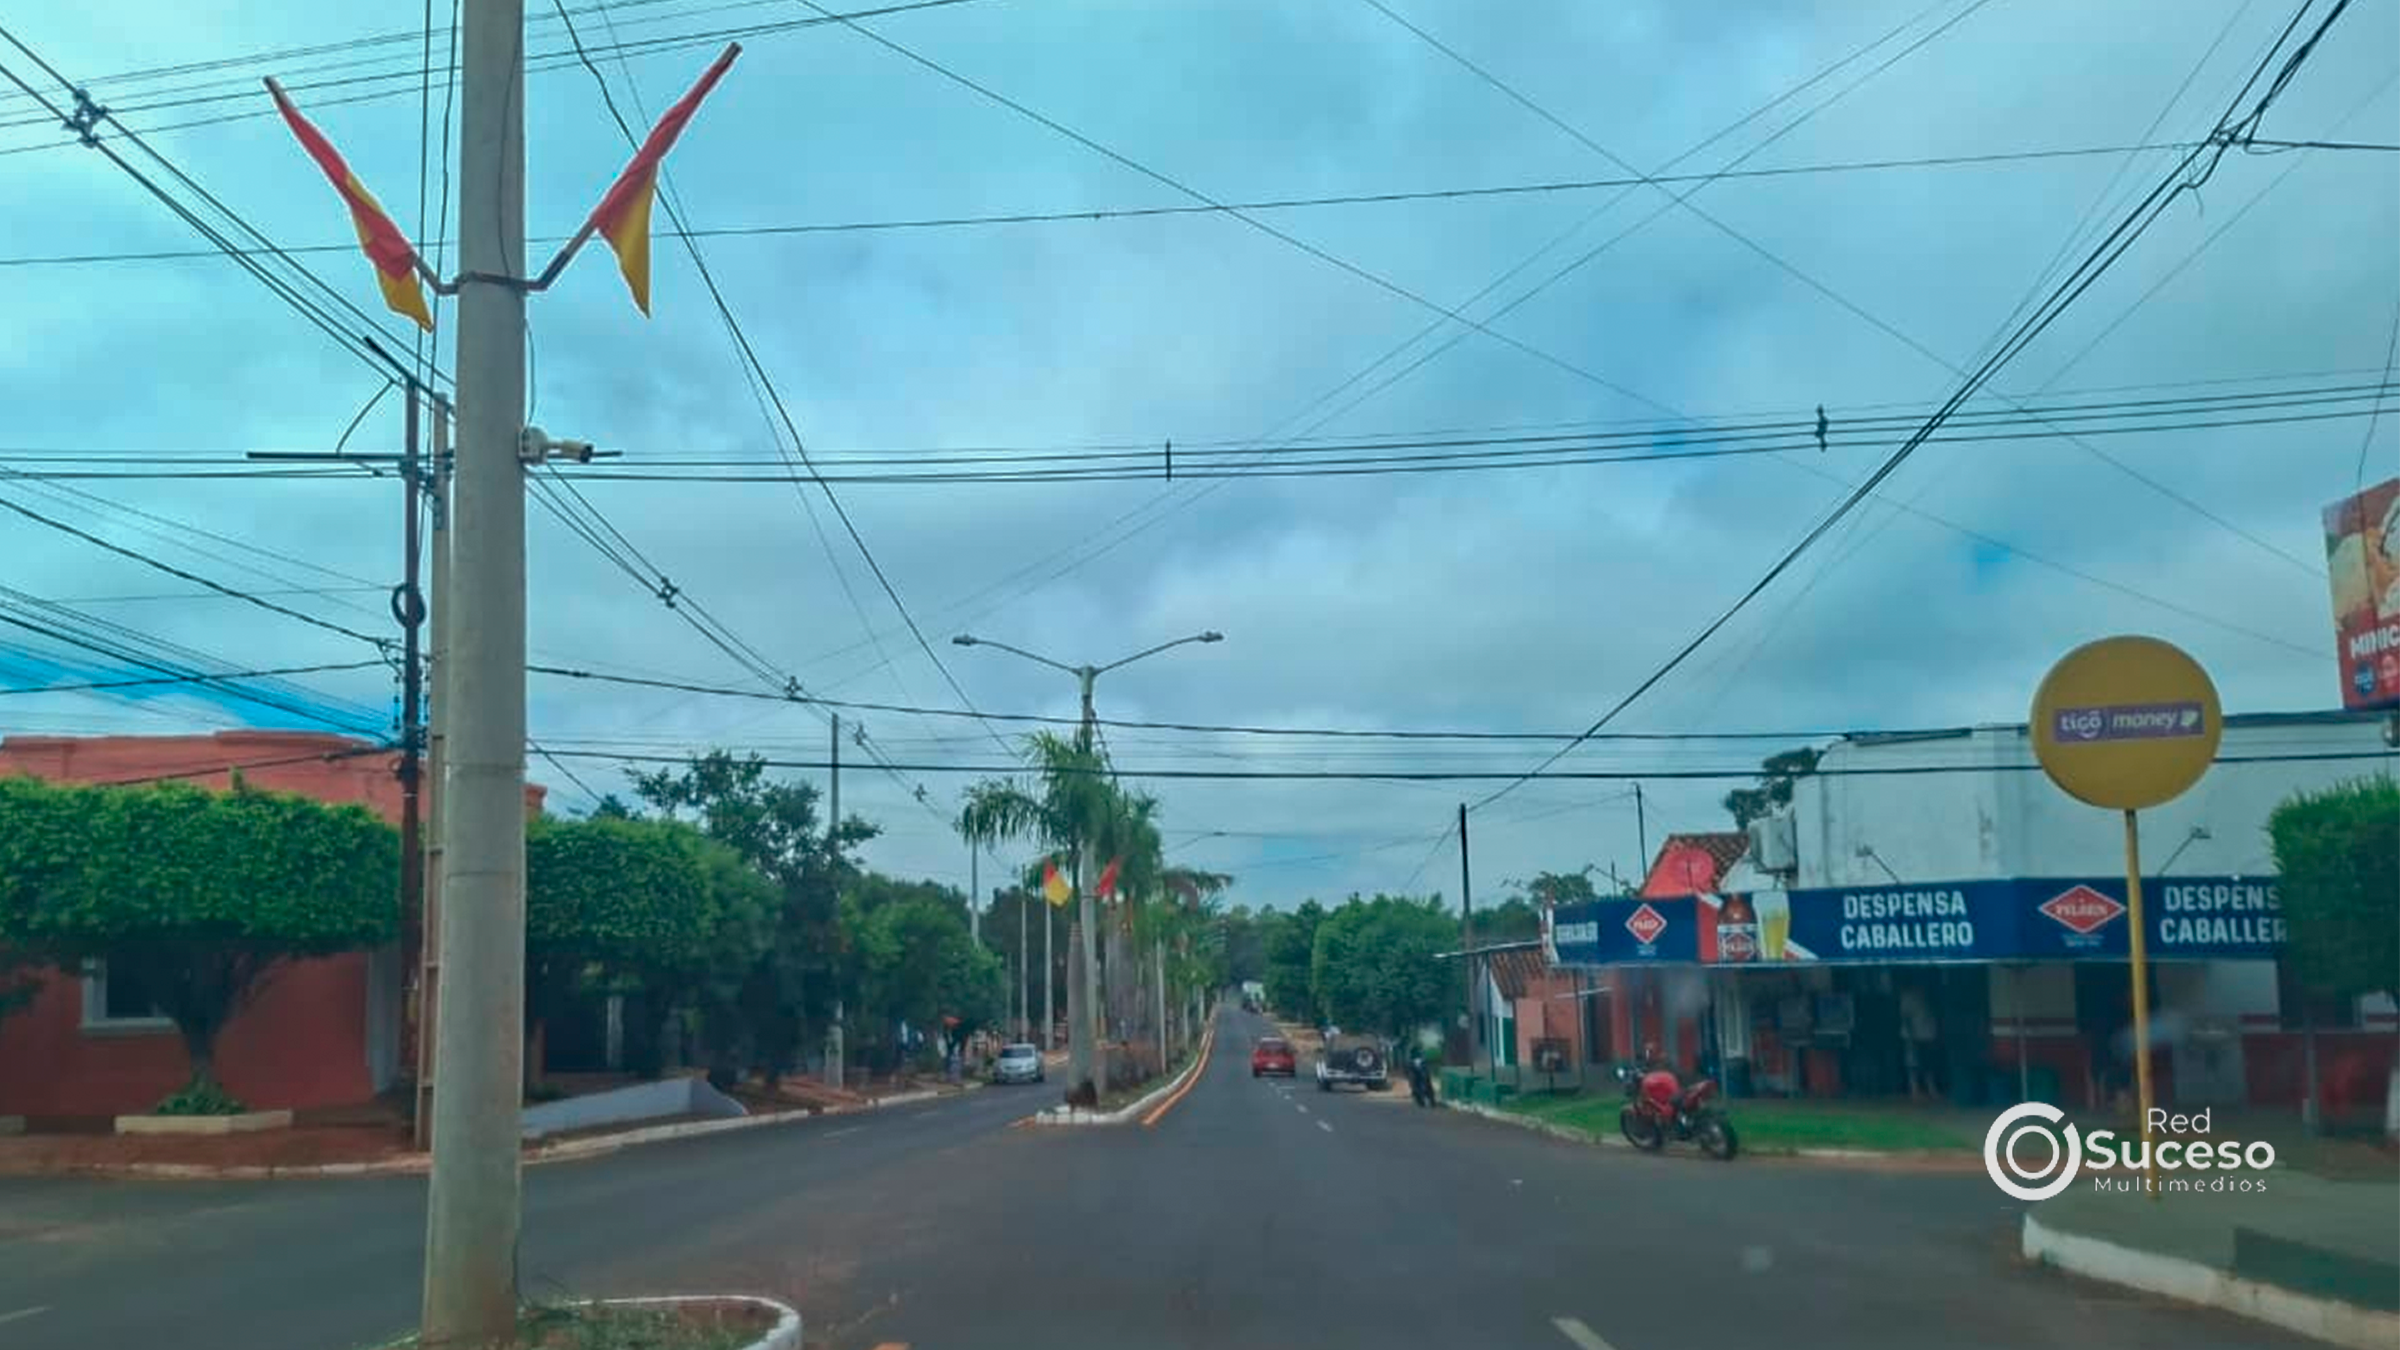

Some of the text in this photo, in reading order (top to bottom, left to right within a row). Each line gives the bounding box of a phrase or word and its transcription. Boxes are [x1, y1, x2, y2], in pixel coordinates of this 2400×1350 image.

[2113, 710, 2177, 729] money
[1844, 891, 1968, 919] DESPENSA
[2164, 885, 2280, 911] DESPENS
[1841, 921, 1974, 949] CABALLERO
[2160, 917, 2288, 943] CABALLER
